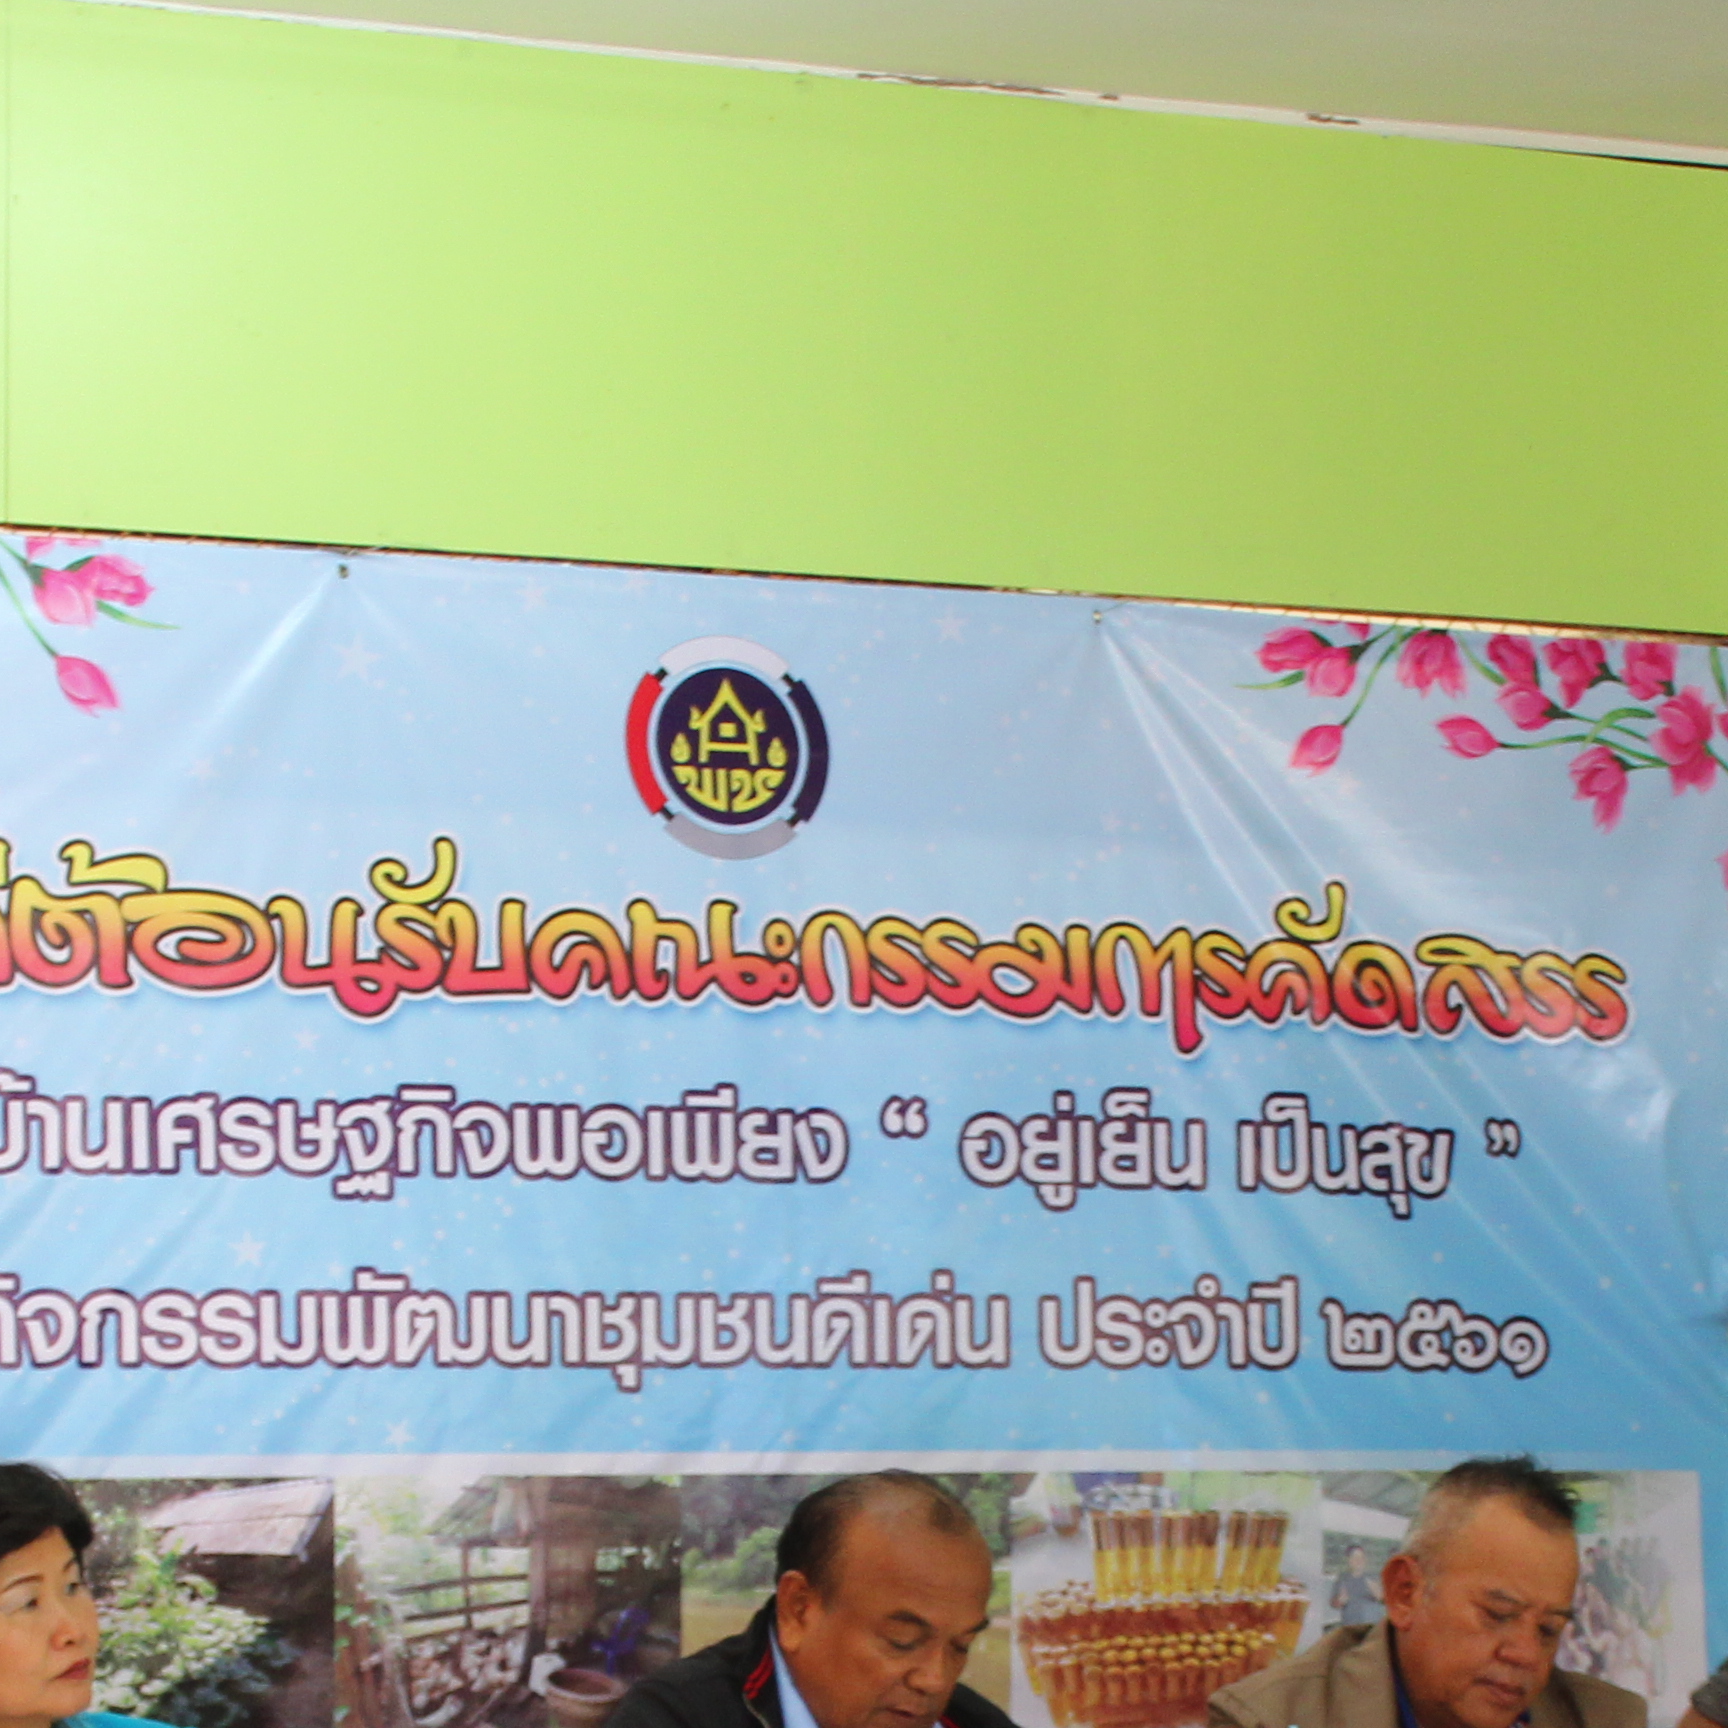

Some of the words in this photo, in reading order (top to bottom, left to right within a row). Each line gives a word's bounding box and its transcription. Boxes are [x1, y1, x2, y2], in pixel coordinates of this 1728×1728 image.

[959, 1088, 1207, 1210] อยู่เย็น
[1236, 1091, 1455, 1219] เป็นสุข
[1037, 1275, 1300, 1370] ประจำปี
[1324, 1298, 1550, 1379] ๒๕๖๑
